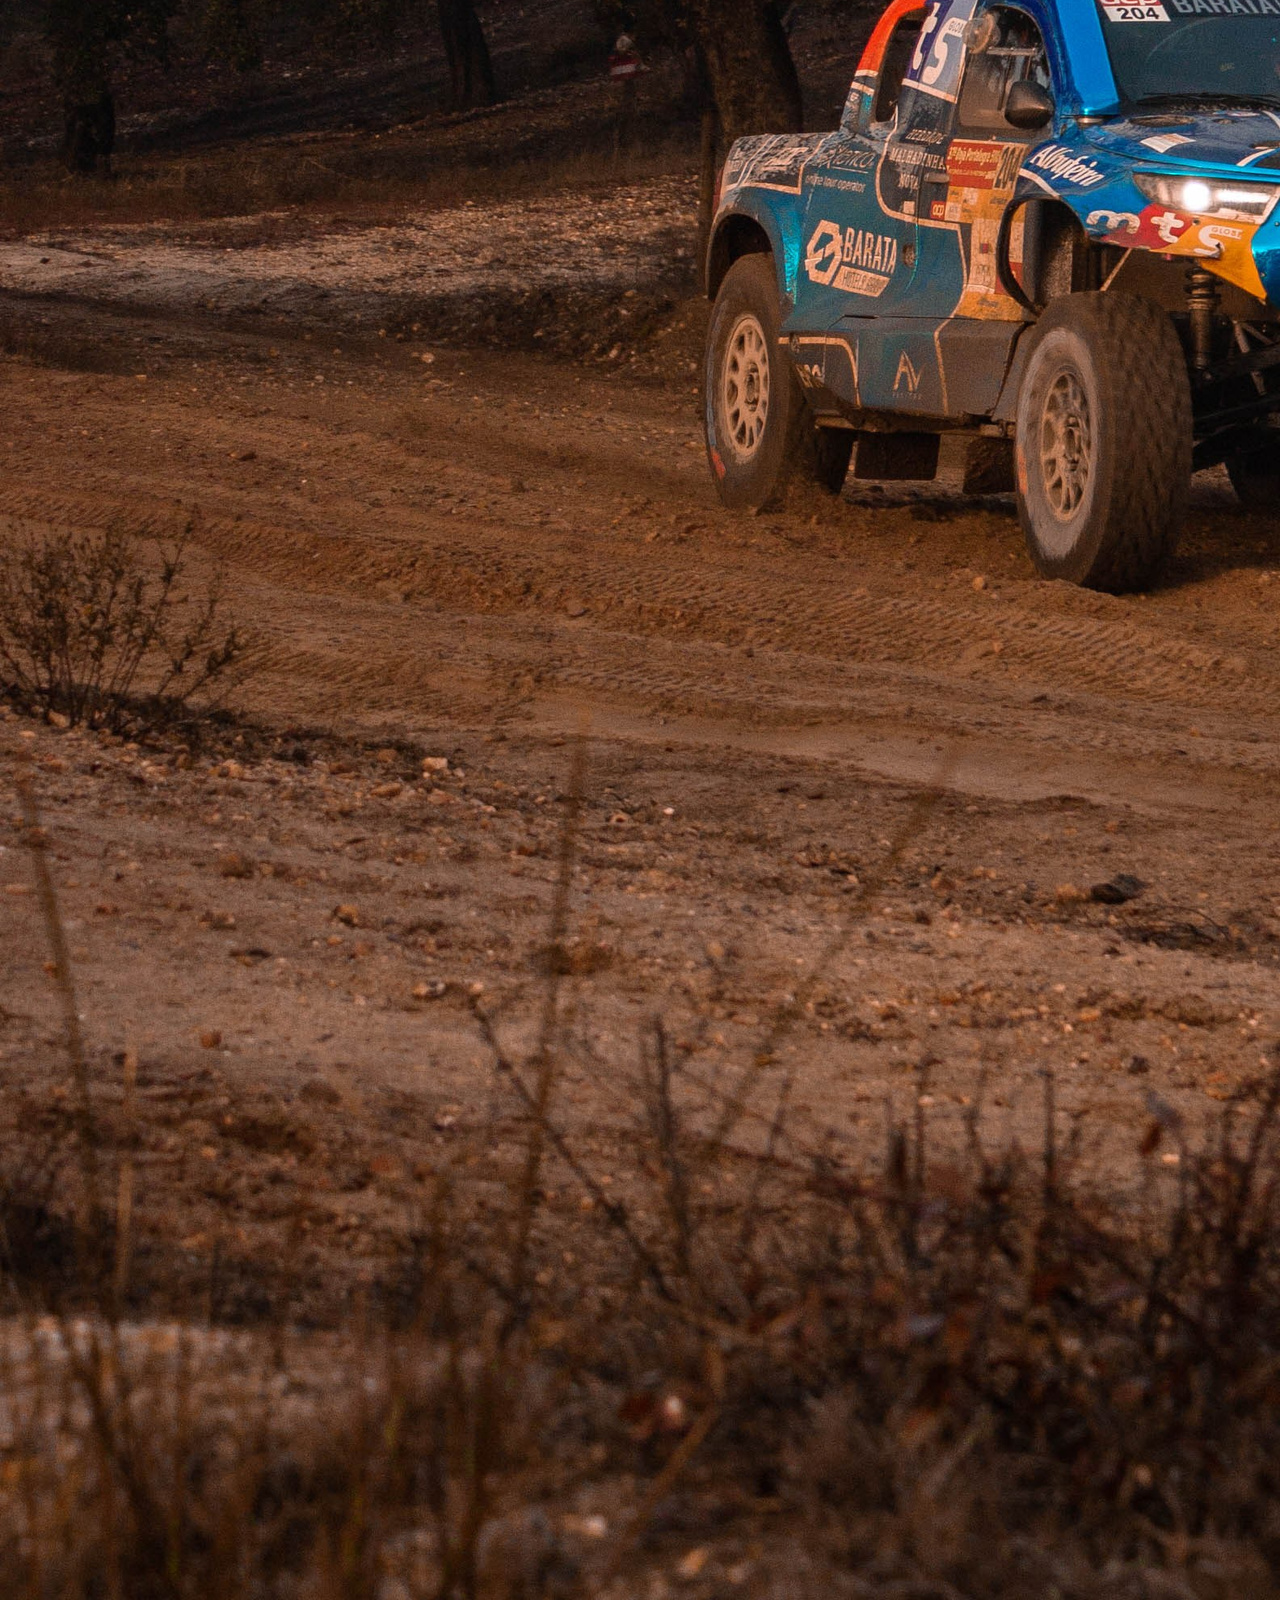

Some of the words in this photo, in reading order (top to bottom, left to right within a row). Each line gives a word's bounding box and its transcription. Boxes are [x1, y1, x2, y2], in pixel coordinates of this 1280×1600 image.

[1116, 6, 1159, 21] 204
[1029, 144, 1105, 187] Albufeira
[843, 227, 898, 275] BARATA
